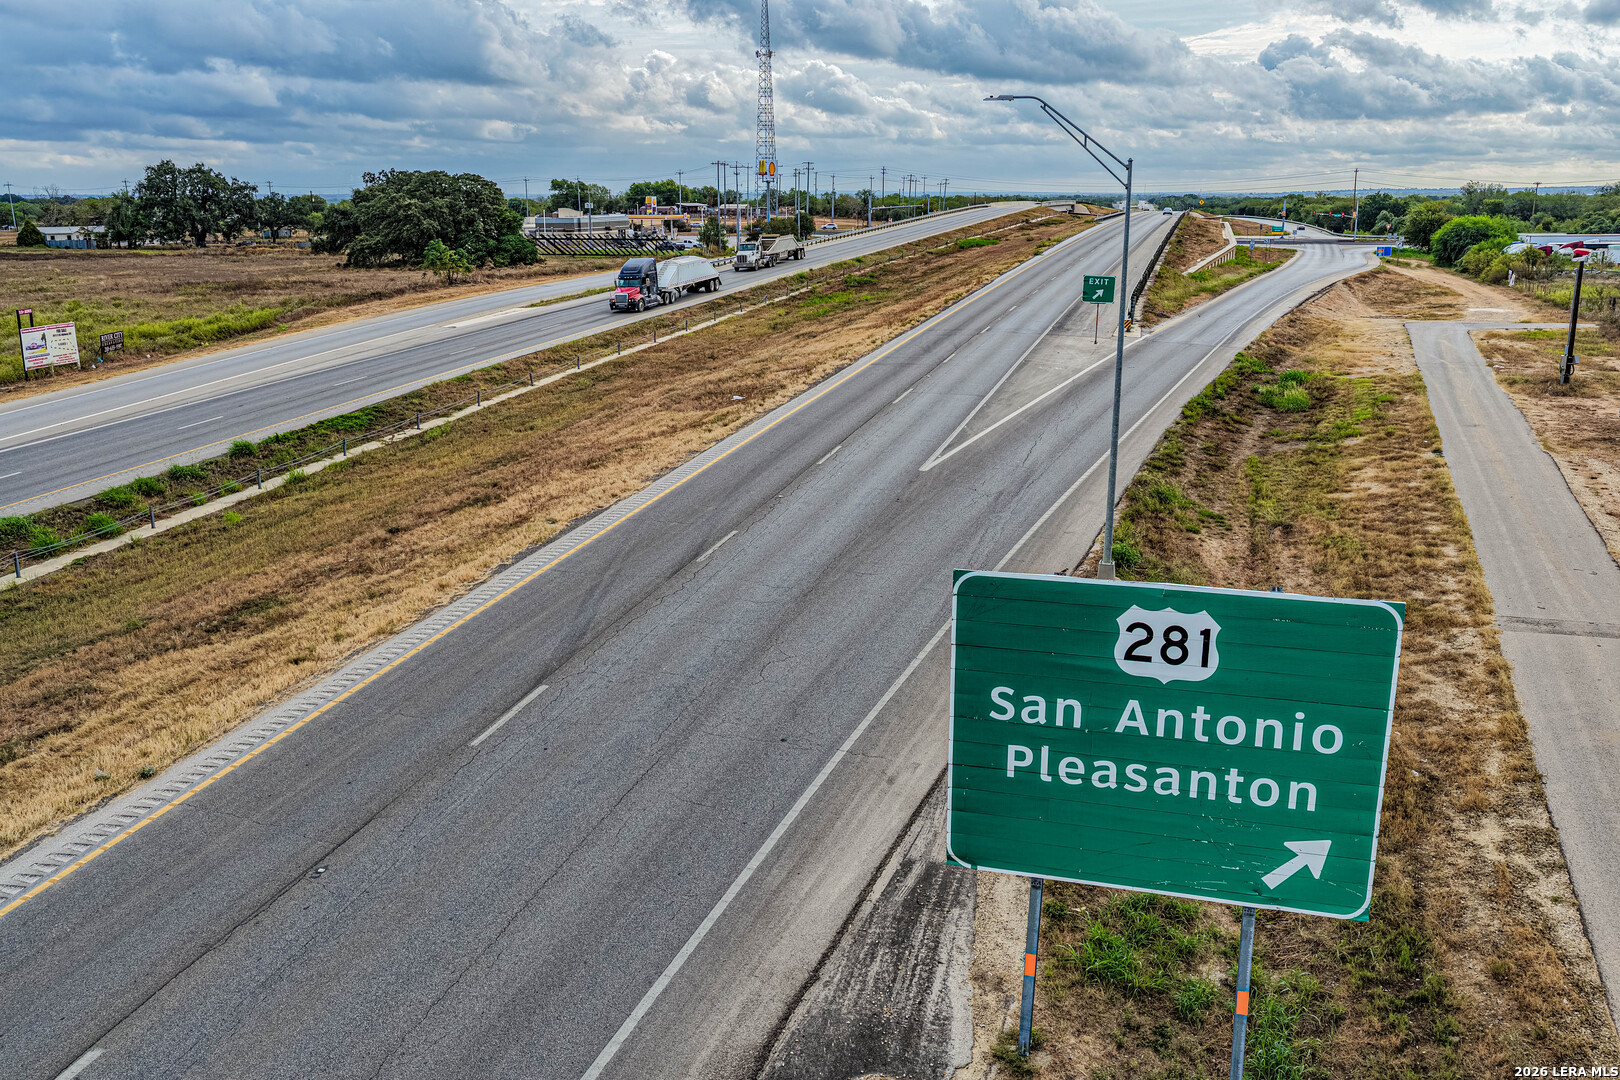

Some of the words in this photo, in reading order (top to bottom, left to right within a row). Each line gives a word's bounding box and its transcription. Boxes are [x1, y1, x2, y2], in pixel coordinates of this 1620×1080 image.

[1088, 278, 1109, 286] EXIT
[113, 331, 124, 339] CITY
[1123, 621, 1211, 669] 281
[989, 686, 1083, 729] San
[1114, 699, 1345, 755] Antonio
[1006, 744, 1318, 812] Pleasanton
